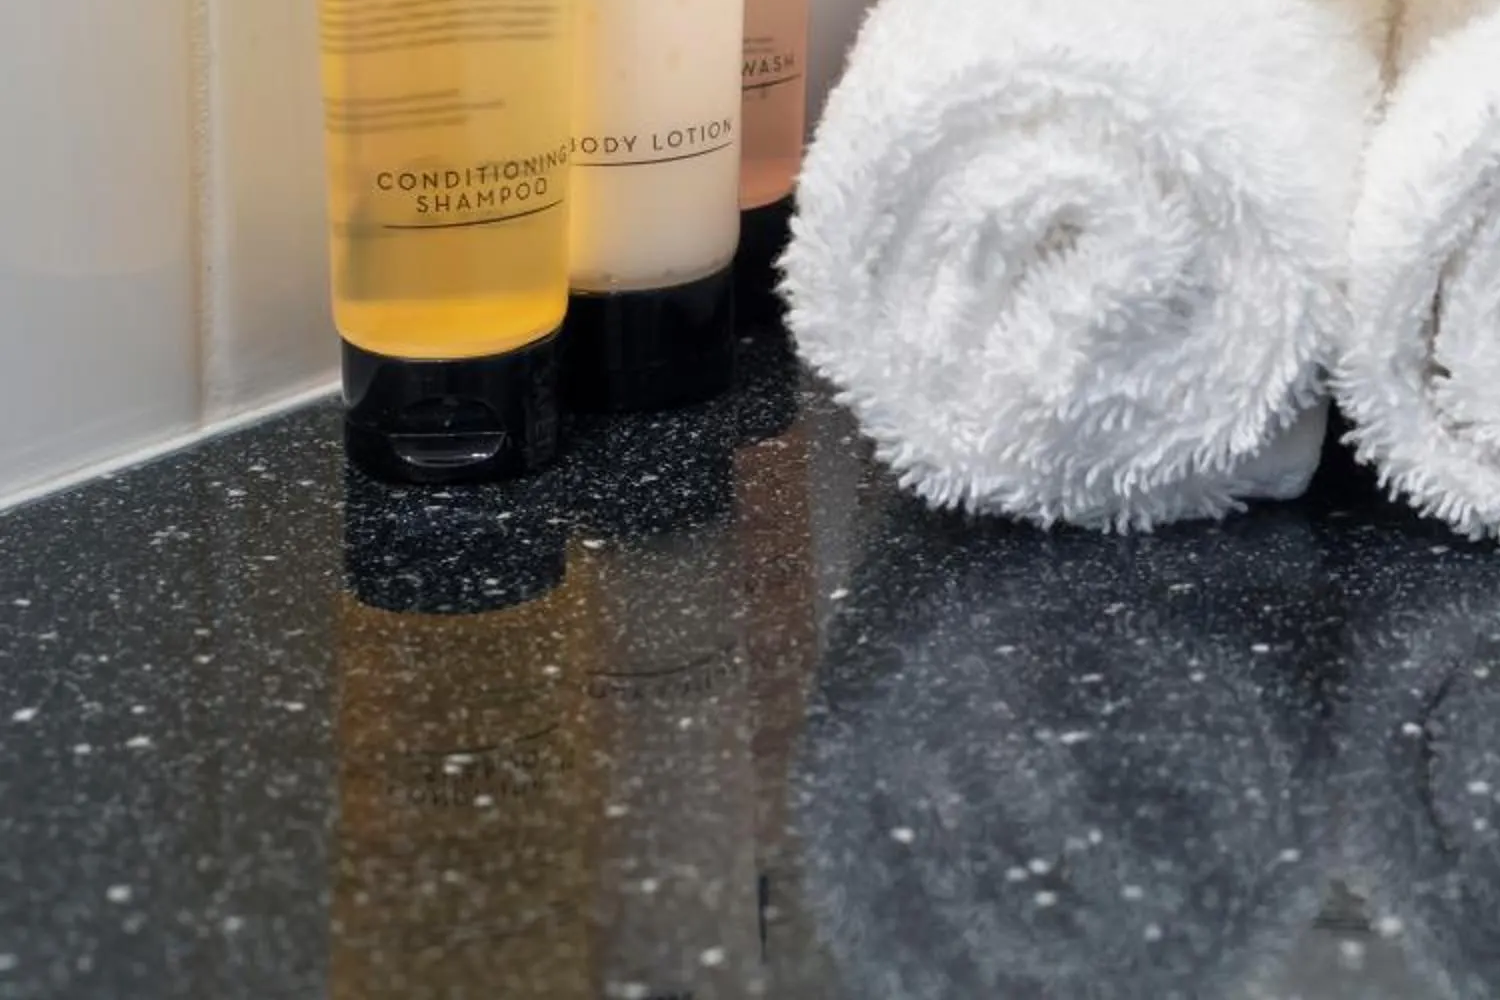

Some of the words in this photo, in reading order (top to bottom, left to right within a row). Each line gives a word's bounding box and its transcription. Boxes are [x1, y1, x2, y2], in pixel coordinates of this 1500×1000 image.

[652, 118, 733, 151] LOTION
[376, 143, 568, 191] CONDITIONING
[416, 177, 548, 214] SHAMPOO
